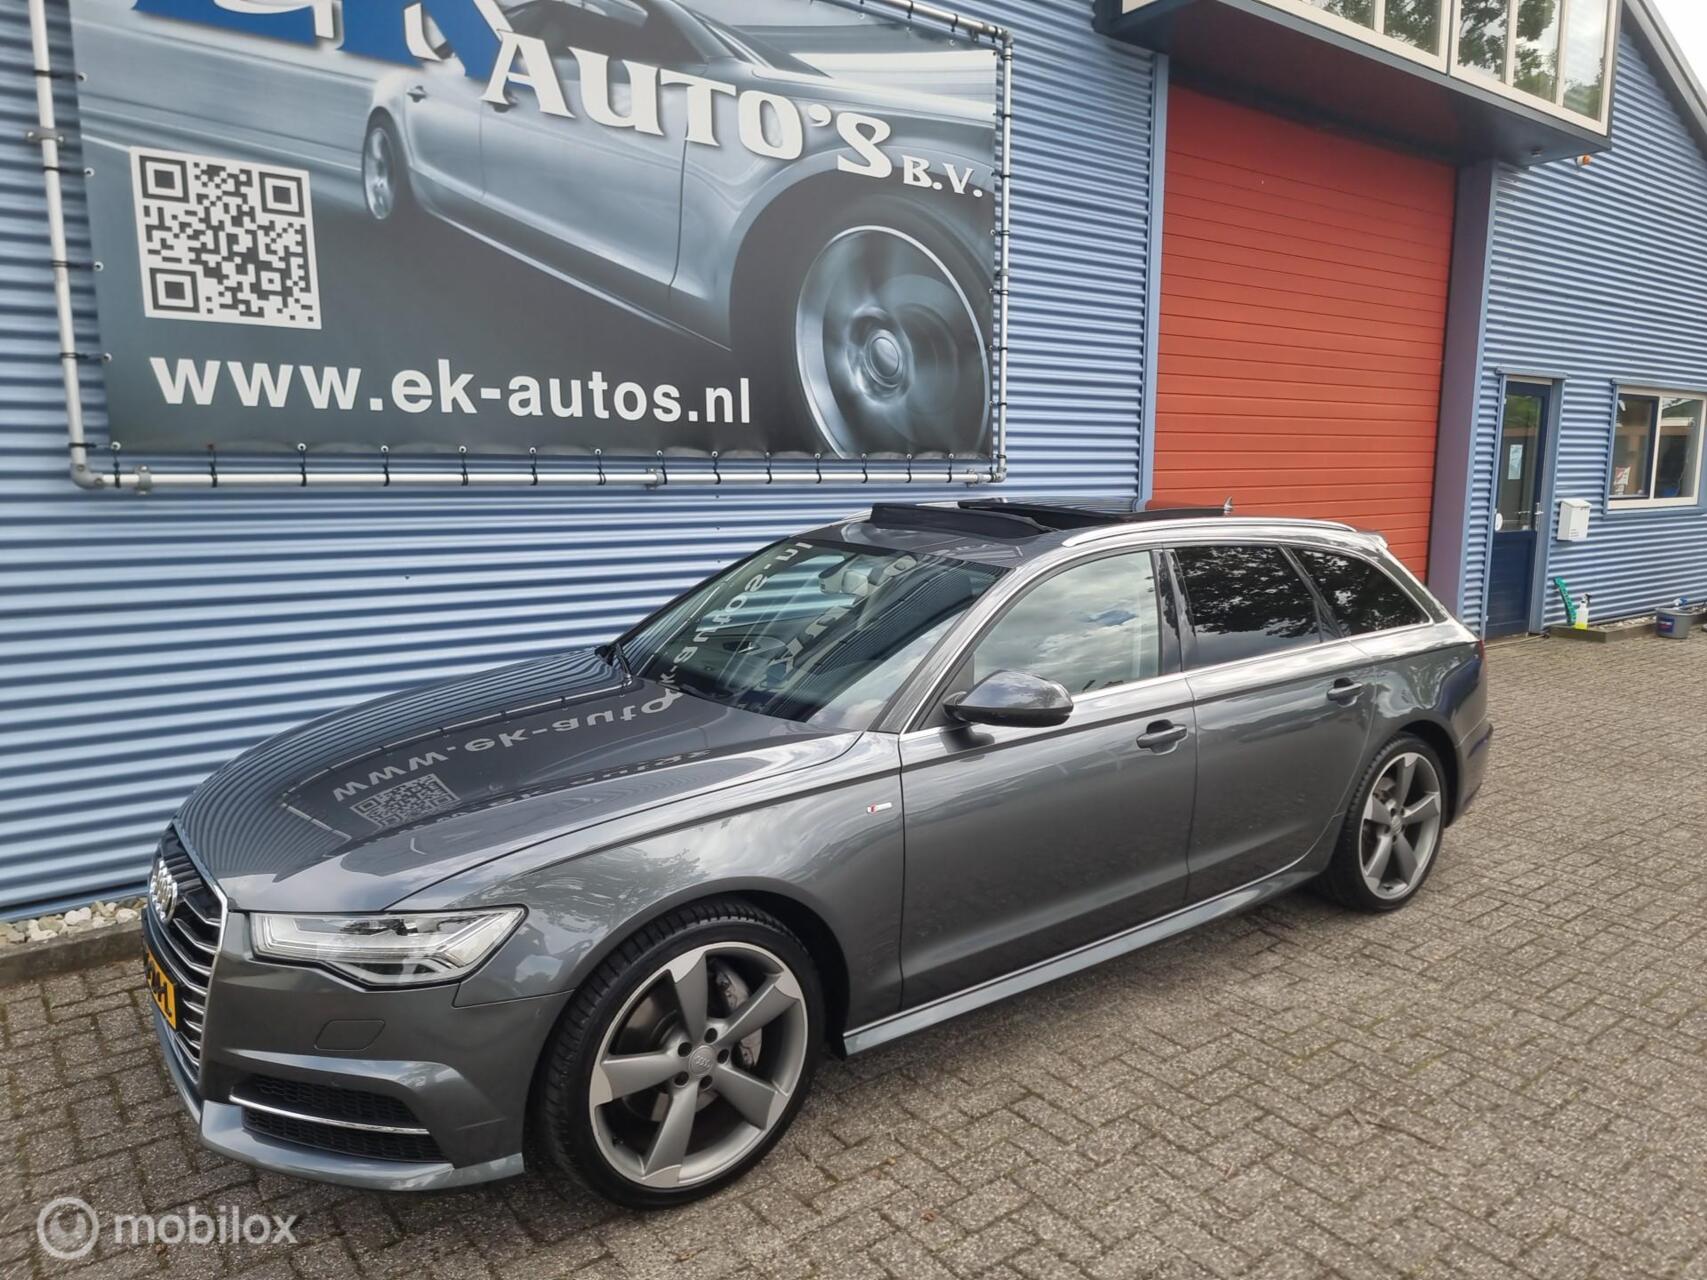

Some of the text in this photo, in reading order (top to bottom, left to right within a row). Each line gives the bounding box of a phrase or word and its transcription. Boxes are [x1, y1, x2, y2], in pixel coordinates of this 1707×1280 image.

[480, 29, 893, 179] AUTO'S
[902, 154, 984, 198] B.V.
[149, 356, 751, 424] www.ek-autos.nl
